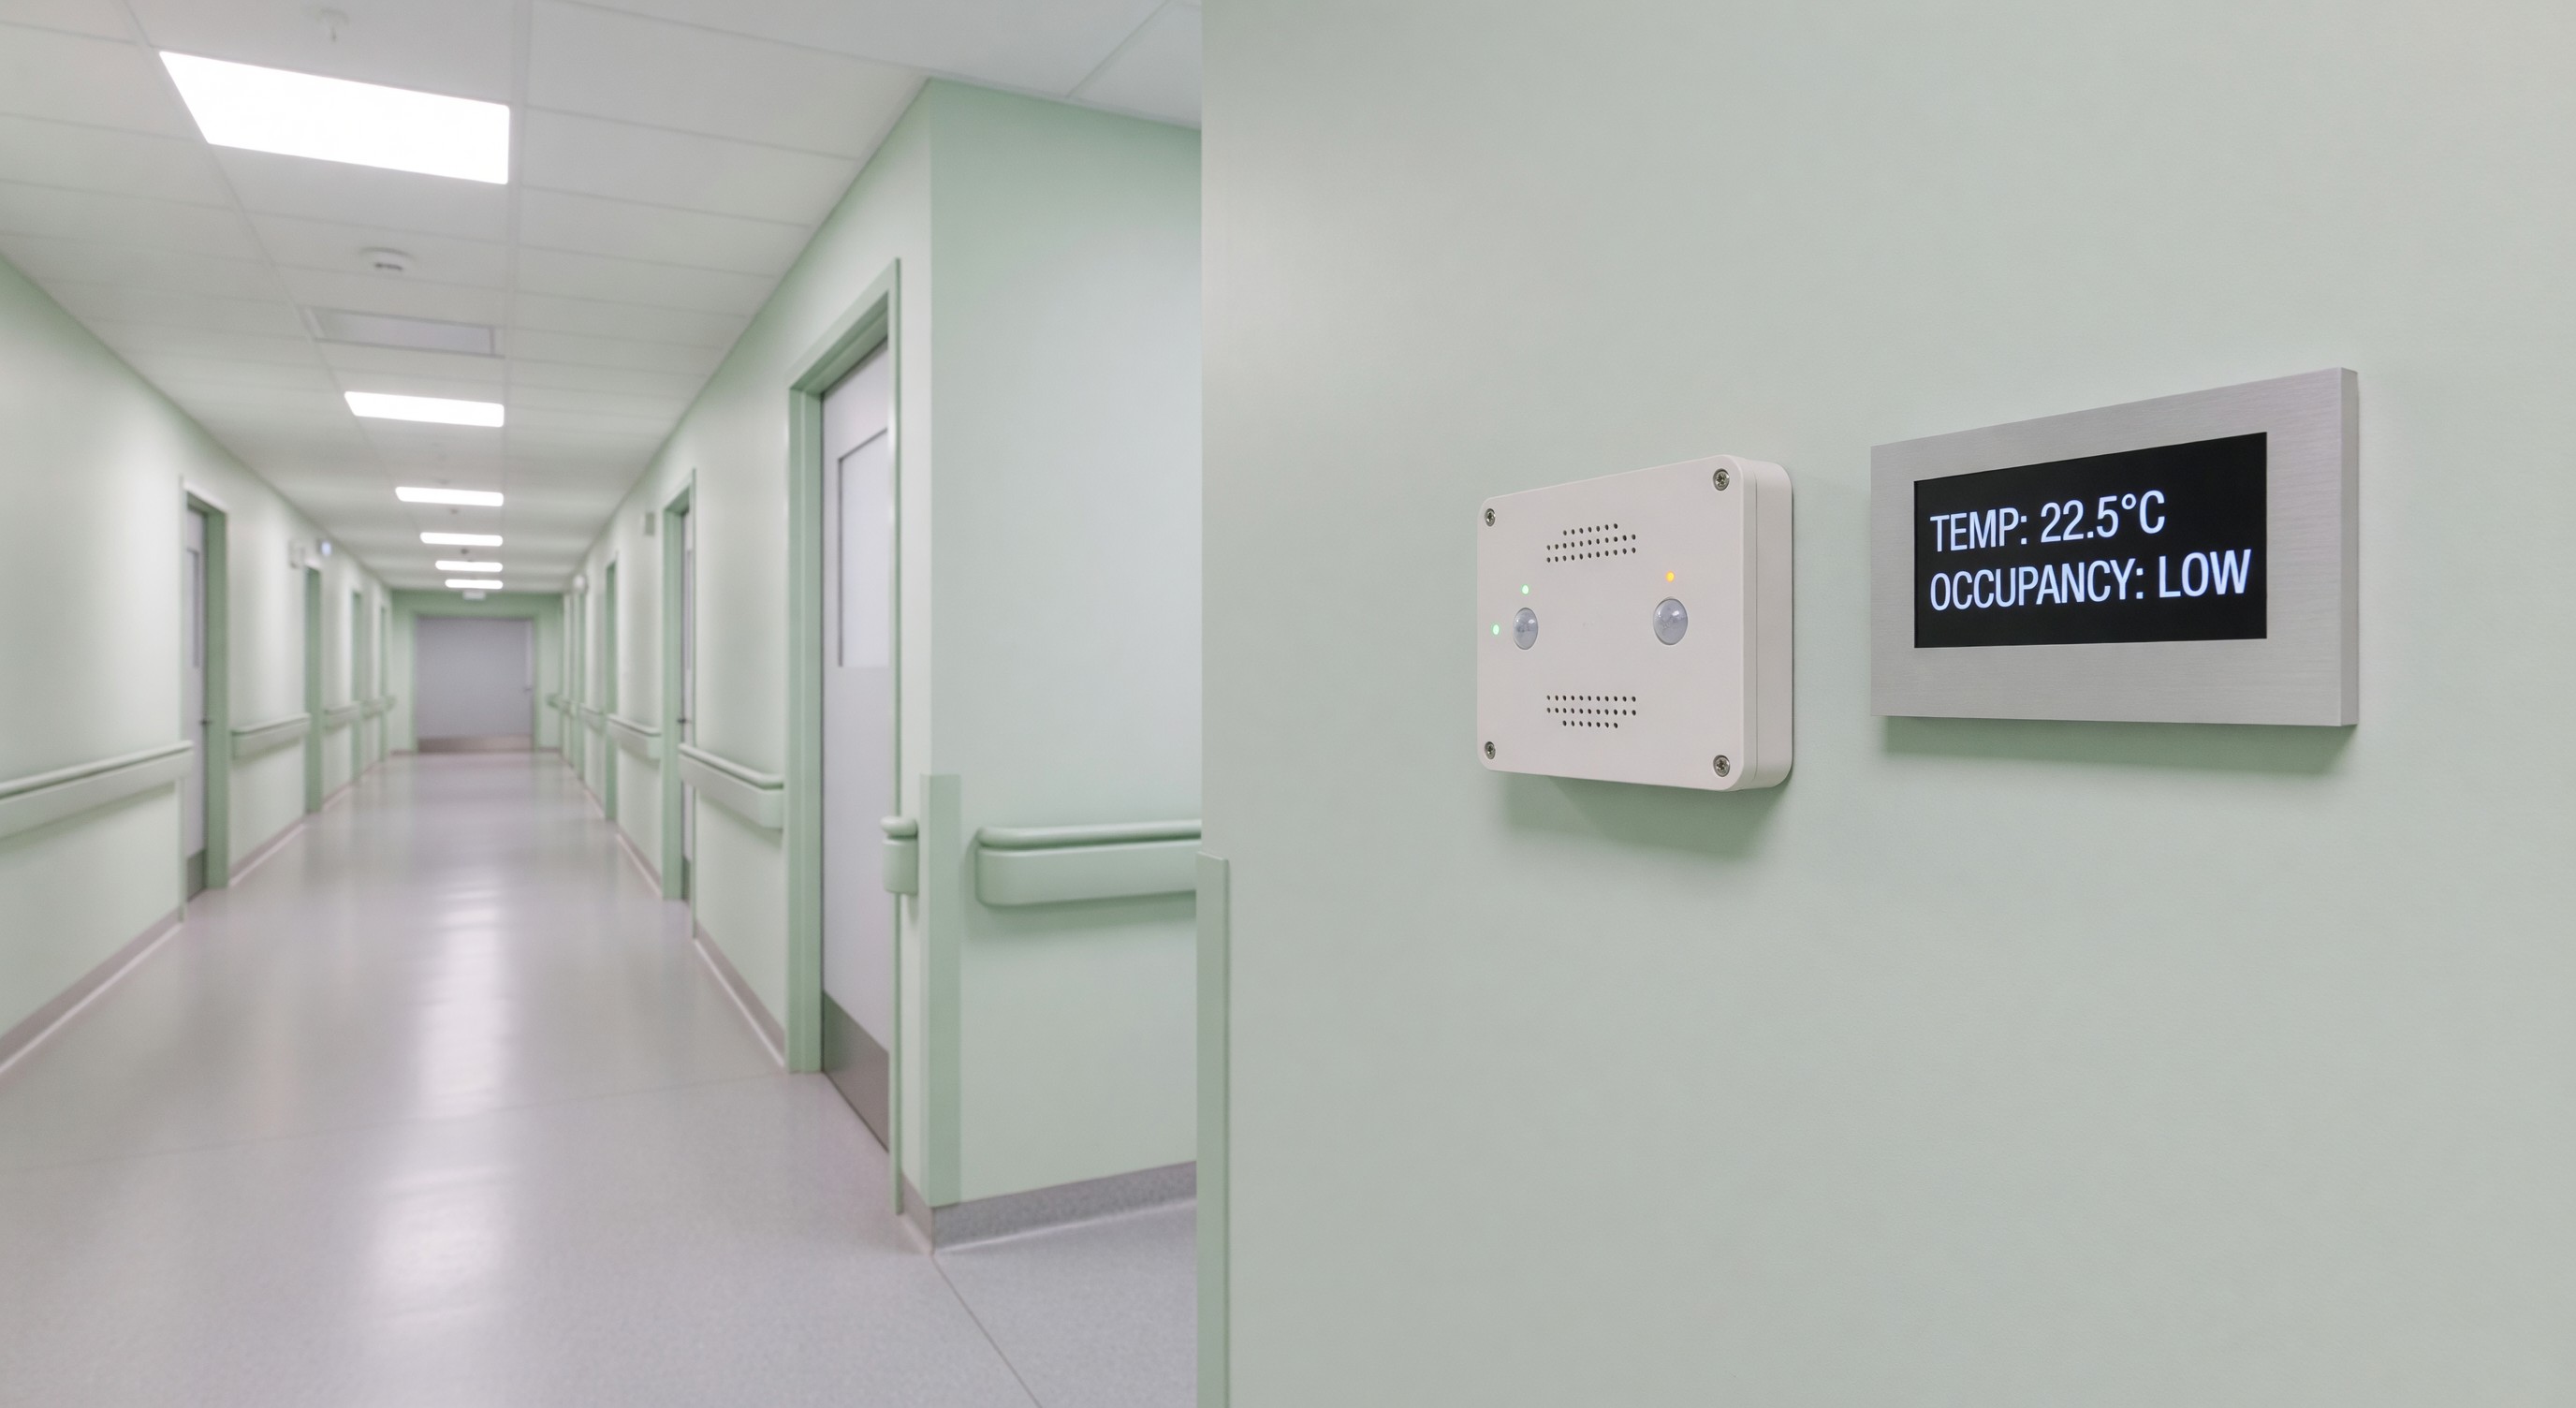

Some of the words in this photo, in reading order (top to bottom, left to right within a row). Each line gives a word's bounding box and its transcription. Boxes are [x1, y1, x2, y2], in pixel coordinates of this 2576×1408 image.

[1929, 506, 2027, 552] TEMP:
[2041, 490, 2166, 544] 22.5°C
[1930, 558, 2144, 611] OCCUPANCY:
[2159, 549, 2252, 598] LOW
